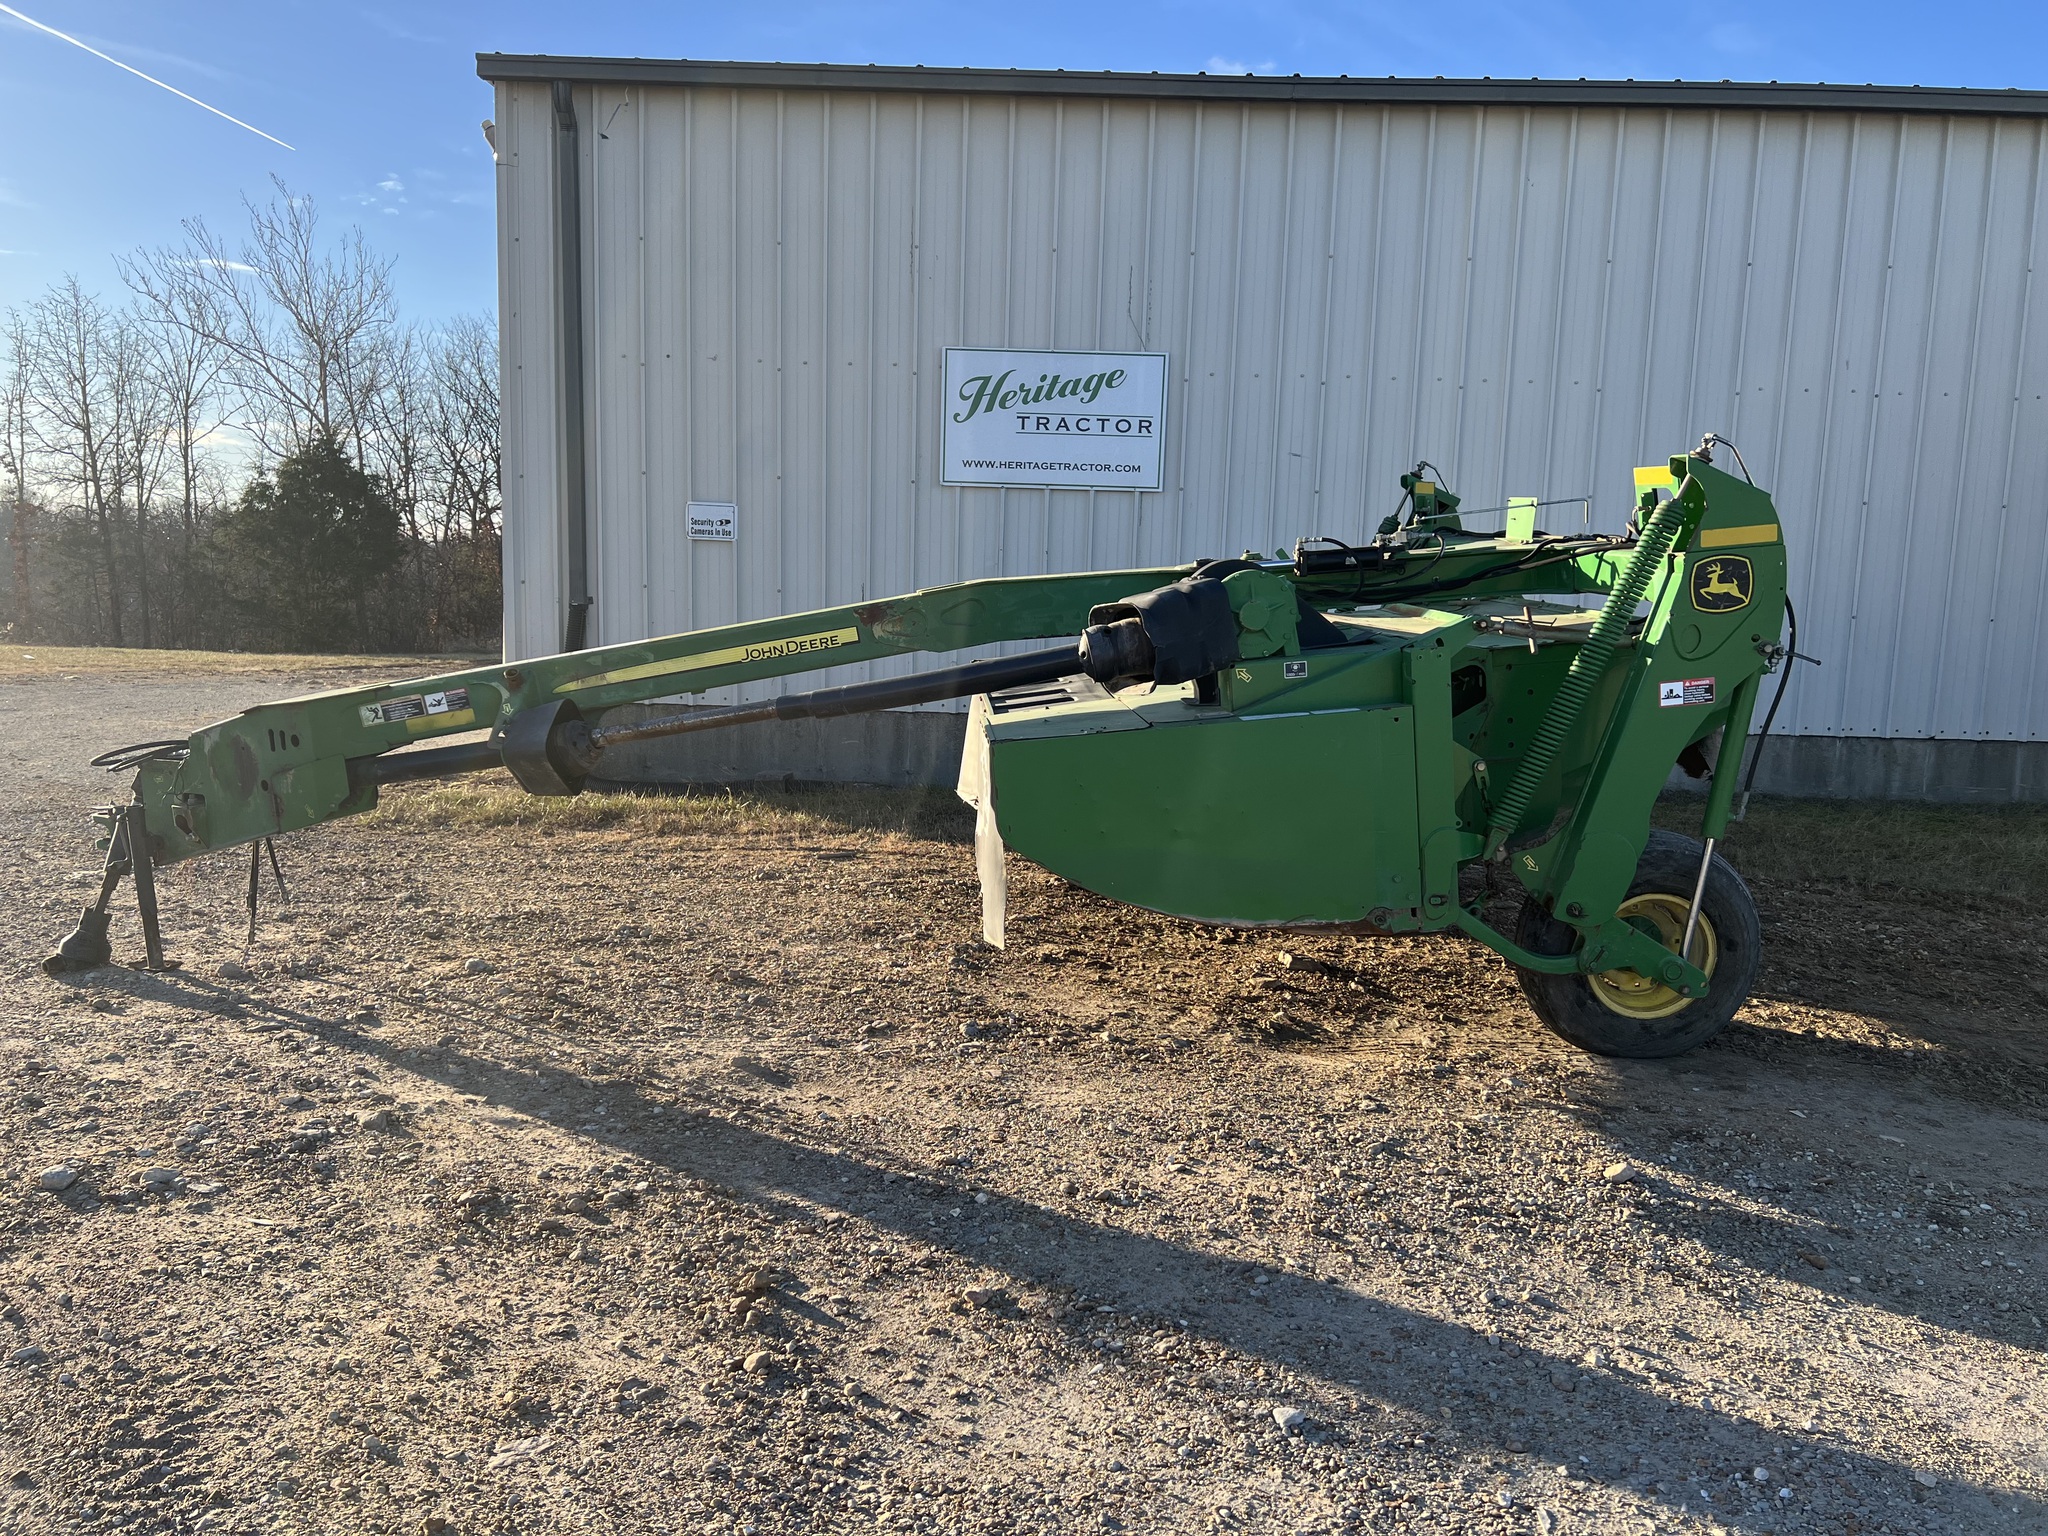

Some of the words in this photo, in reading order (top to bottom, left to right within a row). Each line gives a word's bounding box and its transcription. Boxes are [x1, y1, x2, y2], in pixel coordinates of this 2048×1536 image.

[953, 369, 1127, 423] Heritage
[1016, 415, 1153, 434] TRACTOR
[962, 459, 1141, 473] WWW.HERITAGETRACTOR.COM
[690, 517, 715, 528] Security
[690, 526, 714, 536] Cameras
[721, 528, 732, 537] Use
[741, 644, 785, 661] JOHN
[785, 635, 840, 653] DEERE
